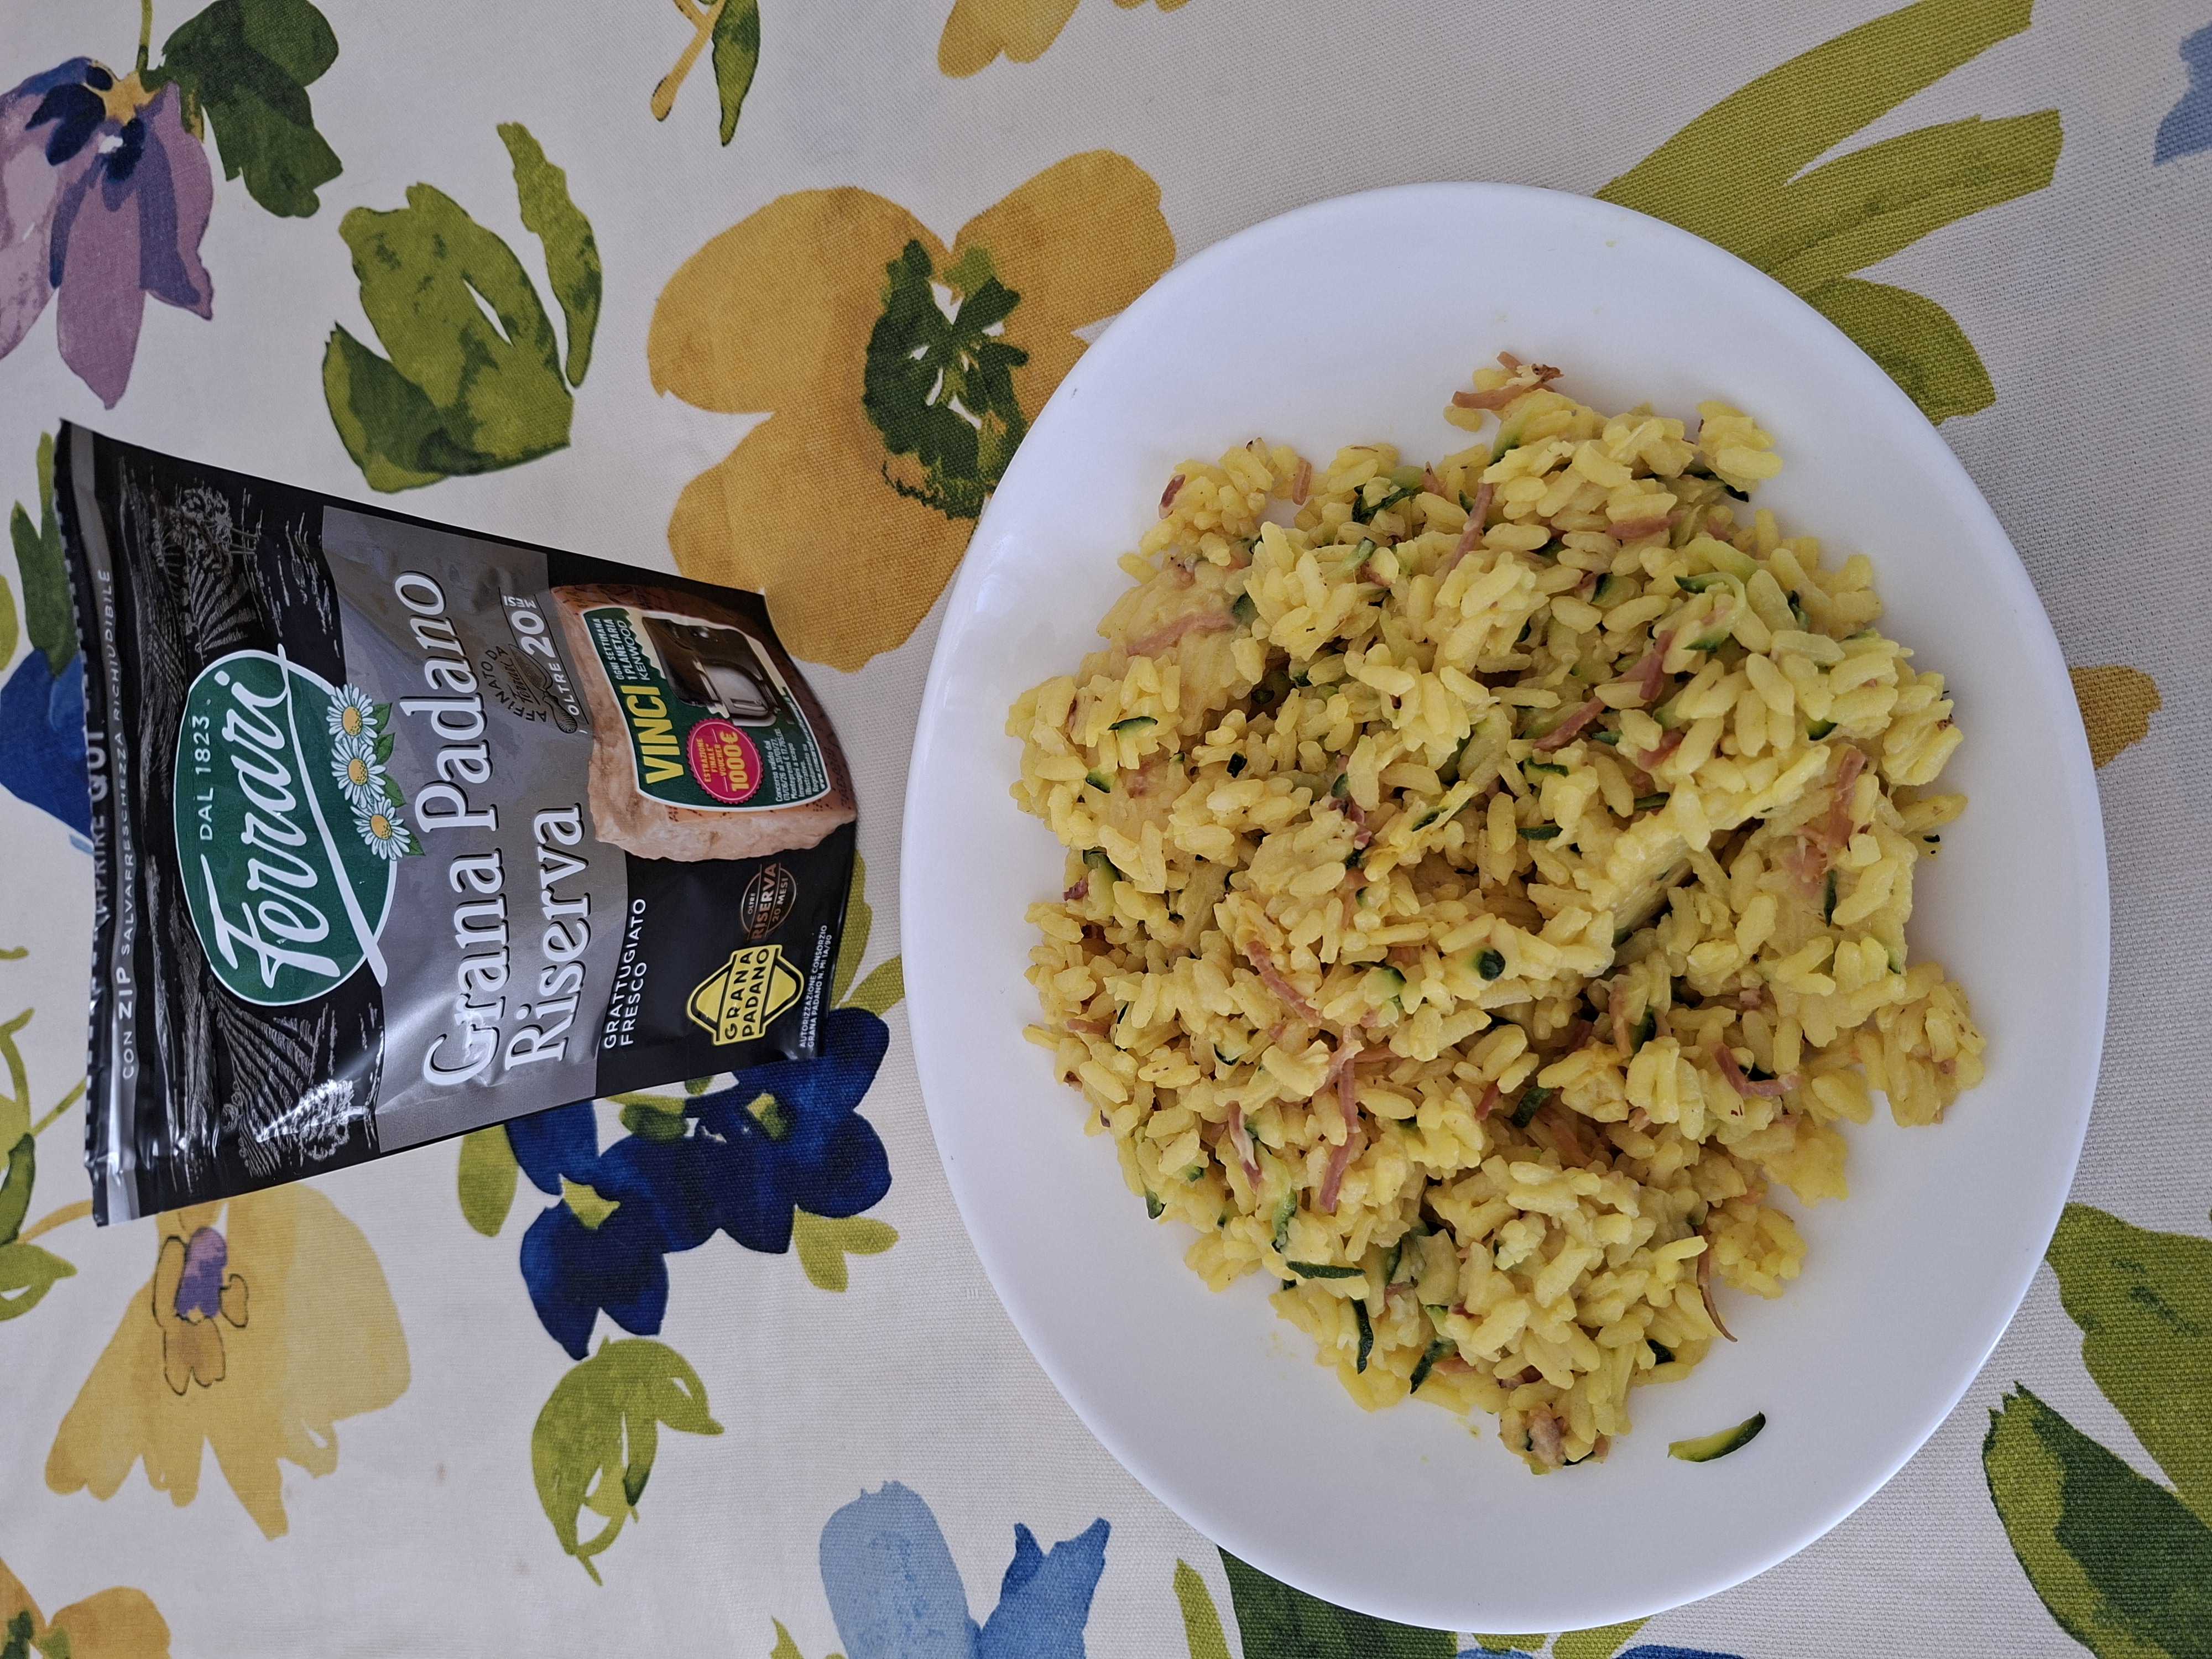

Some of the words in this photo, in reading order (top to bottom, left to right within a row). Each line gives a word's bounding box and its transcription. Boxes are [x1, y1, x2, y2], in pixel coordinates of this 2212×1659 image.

[503, 596, 536, 608] MESI
[97, 570, 121, 720] RICHIUDIBILE
[486, 646, 508, 661] DA
[511, 611, 556, 658] 20
[593, 618, 616, 660] SETTIMANA
[604, 619, 634, 674] PLANETARIA
[617, 620, 650, 680] KENWOOD
[481, 661, 546, 722] AFFINATO
[500, 658, 534, 703] Ferrari
[548, 663, 580, 716] OLTRE
[611, 662, 624, 680] OGNI
[392, 571, 497, 833] Padano
[192, 715, 211, 775] 1823
[620, 685, 684, 784] VINCI
[696, 738, 712, 782] ESTRAZIONE
[714, 744, 727, 776] VOUCHER
[764, 740, 772, 750] dal
[767, 752, 776, 770] valido
[789, 743, 798, 761] scopo
[720, 732, 749, 791] 1000€
[773, 772, 782, 801] Concorso
[786, 762, 797, 799] Montepremi
[795, 768, 805, 797] Immagini
[806, 753, 819, 792] Regolamento
[199, 787, 213, 841] DAL
[201, 669, 340, 987] Ferrari
[112, 733, 135, 955] SALVAFRESCHEZZA
[747, 893, 756, 915] OLTRE
[751, 863, 778, 939] RISERVA
[771, 906, 781, 921] 20
[776, 878, 789, 905] MESI
[505, 804, 591, 1071] Riserva
[115, 967, 133, 1019] ZIP
[424, 848, 507, 1086] Grana
[604, 899, 646, 1048] GRATTUGIATO
[742, 949, 770, 1036] PADANO
[800, 975, 816, 1047] AUTORIZZAZIONE
[811, 925, 827, 973] CONSORZIO
[620, 962, 647, 1046] FRESCO
[724, 952, 753, 1040] GRANA
[807, 1018, 817, 1047] GRANA
[812, 981, 822, 1015] PADANO
[122, 1031, 135, 1079] CON
